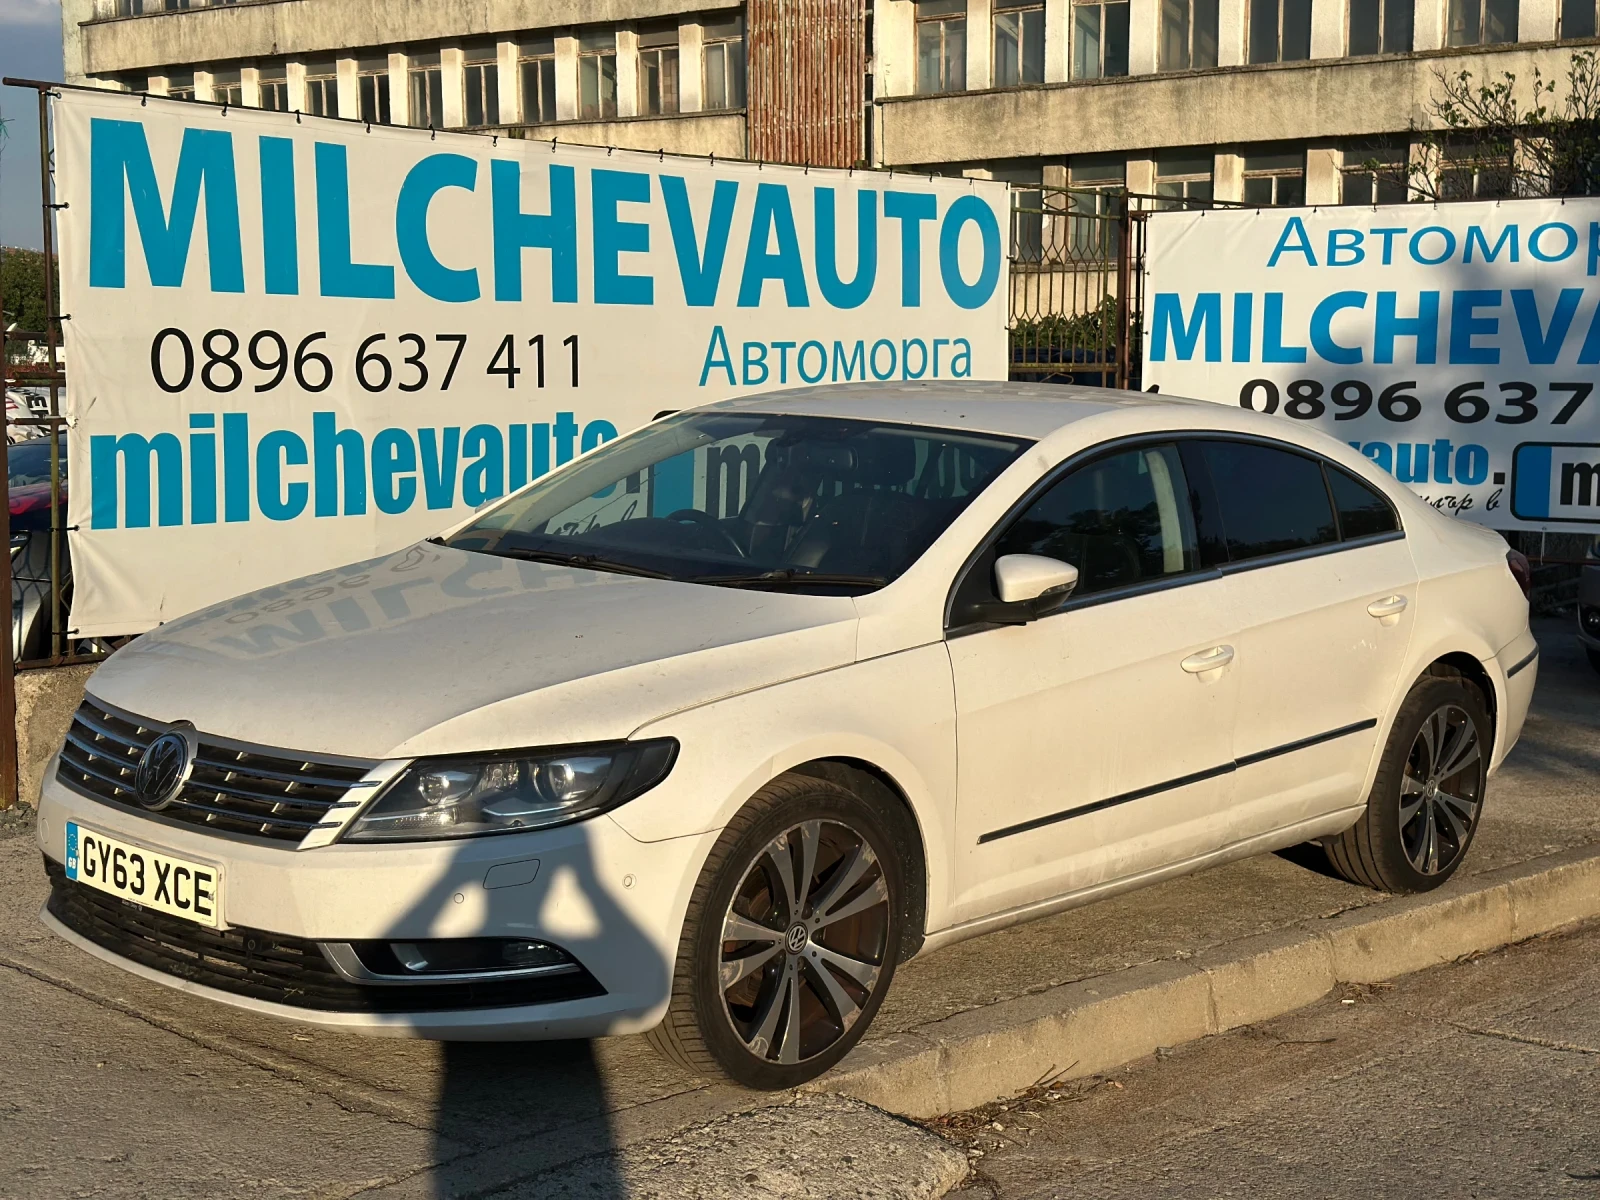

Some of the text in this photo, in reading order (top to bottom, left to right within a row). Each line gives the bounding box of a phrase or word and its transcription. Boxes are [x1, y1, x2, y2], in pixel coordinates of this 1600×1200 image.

[90, 119, 1001, 310] MILCHEVAUTO
[150, 327, 579, 394] 0896 637 411
[699, 325, 972, 386] Автоморга
[1239, 378, 1594, 425] 0896 637
[1348, 439, 1506, 486] auto.
[83, 835, 212, 917] GY63 XCE
